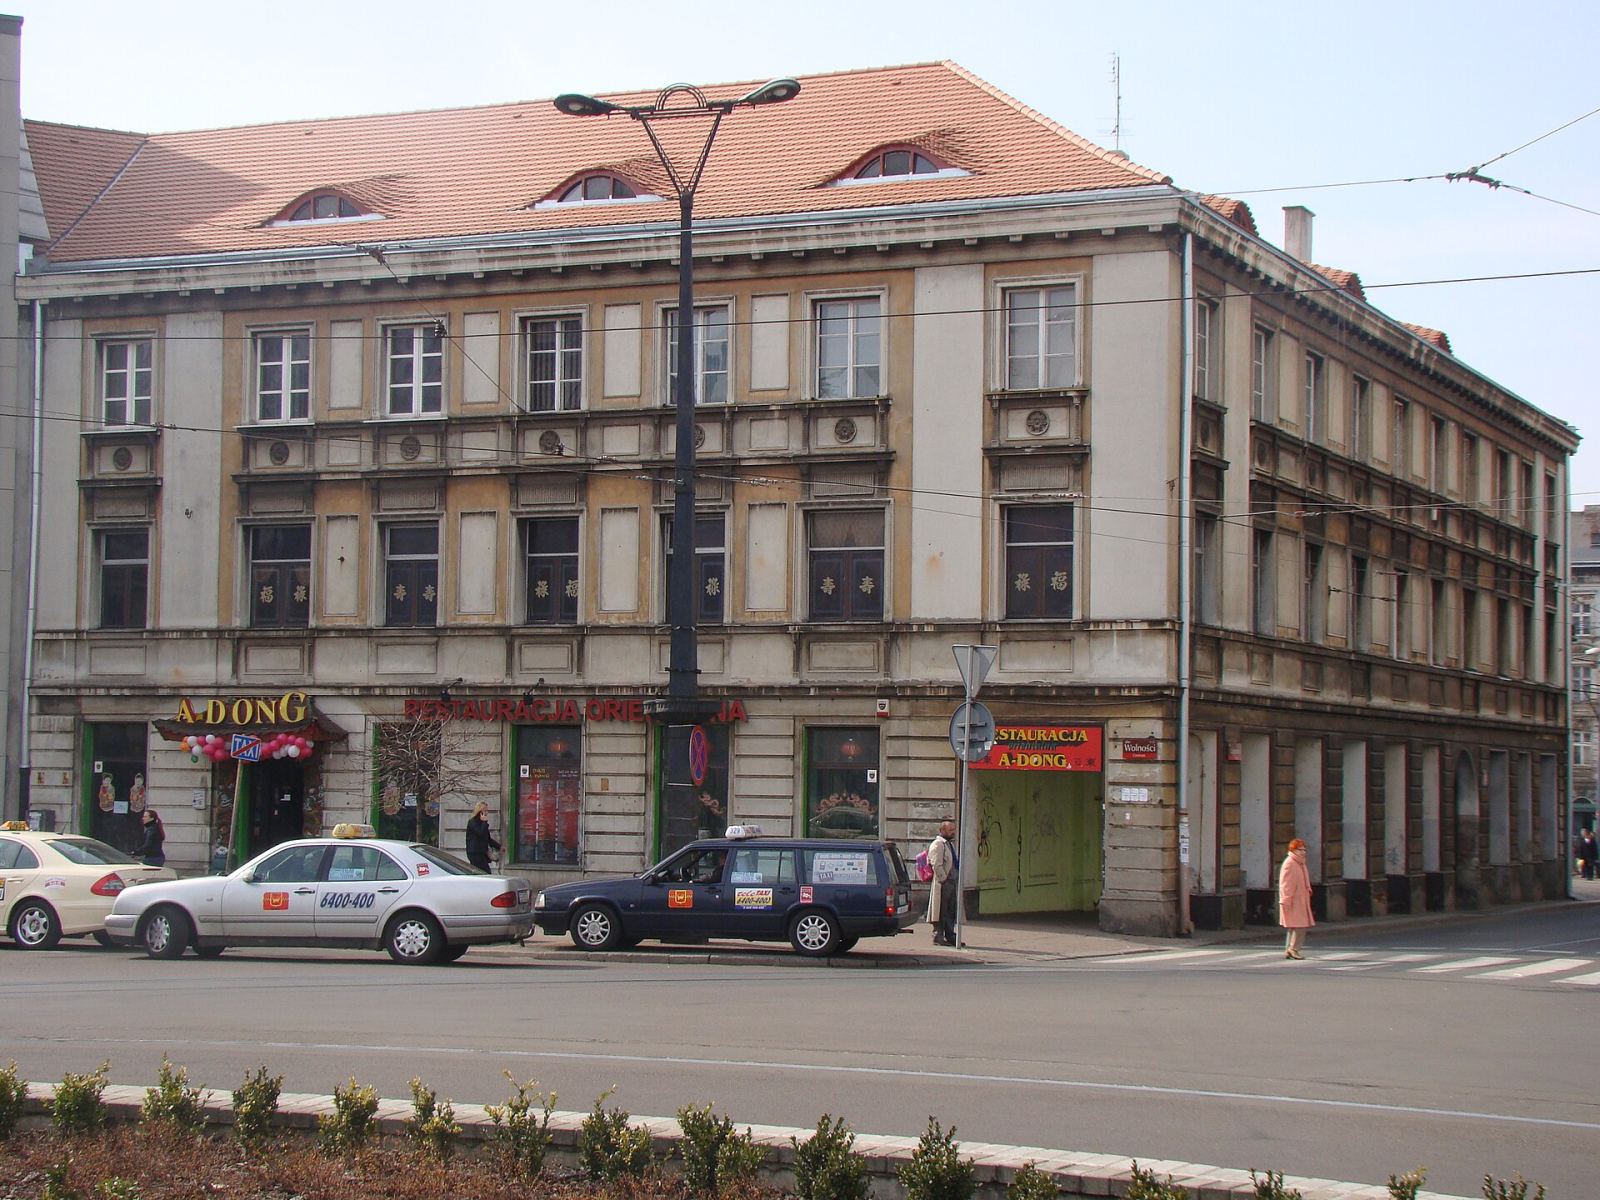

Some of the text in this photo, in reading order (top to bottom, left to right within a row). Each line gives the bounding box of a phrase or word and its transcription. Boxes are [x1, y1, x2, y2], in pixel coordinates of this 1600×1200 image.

[404, 699, 580, 721] RESTAURACJA
[994, 729, 1089, 742] STAURACJA
[233, 737, 260, 759] TAXI
[1124, 743, 1156, 752] Wolności
[998, 753, 1068, 767] A-DONG
[820, 872, 834, 880] TAXI
